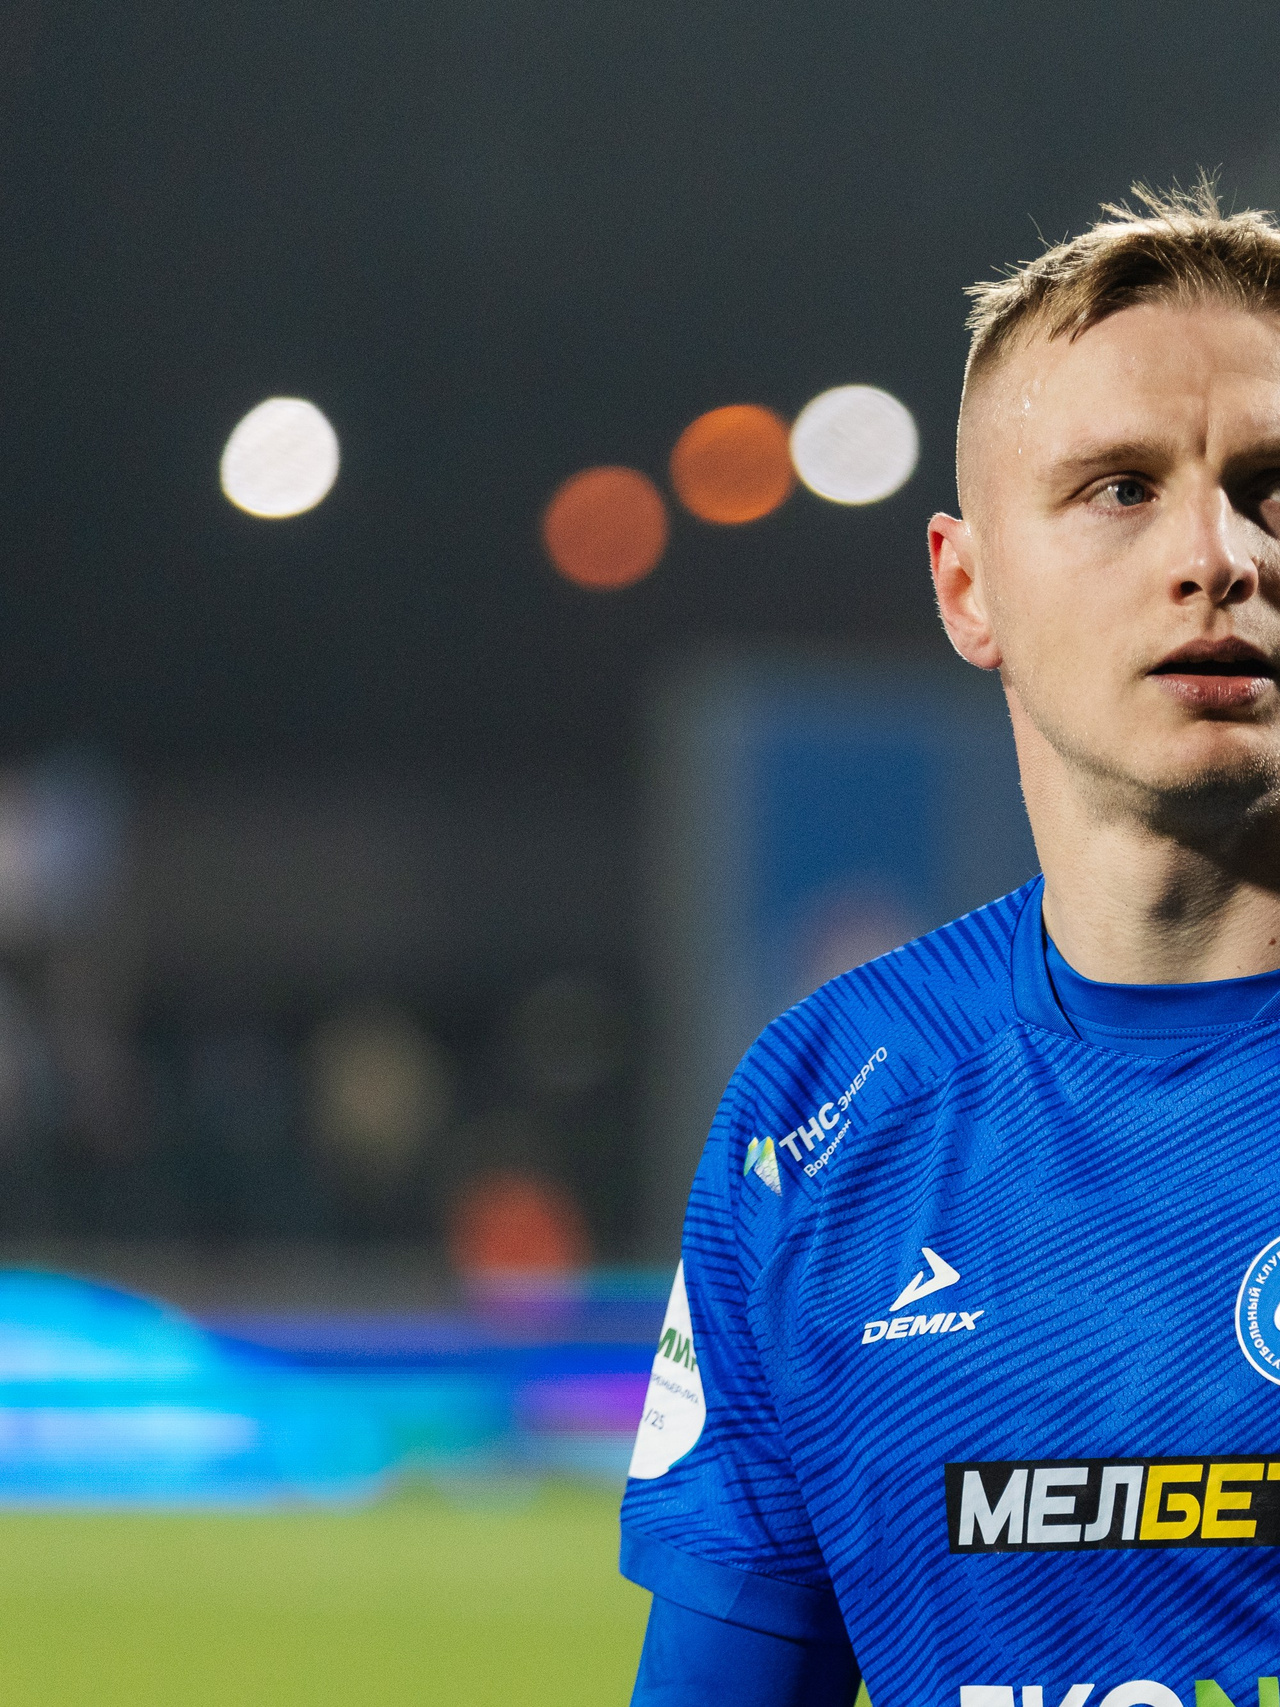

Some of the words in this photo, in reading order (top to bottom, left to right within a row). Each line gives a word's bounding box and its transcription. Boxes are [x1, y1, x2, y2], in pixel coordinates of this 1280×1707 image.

[778, 1102, 840, 1162] ТНС
[837, 1046, 888, 1112] ЭНЕРГО
[803, 1118, 852, 1178] Воронеж
[861, 1310, 985, 1345] DEMIX
